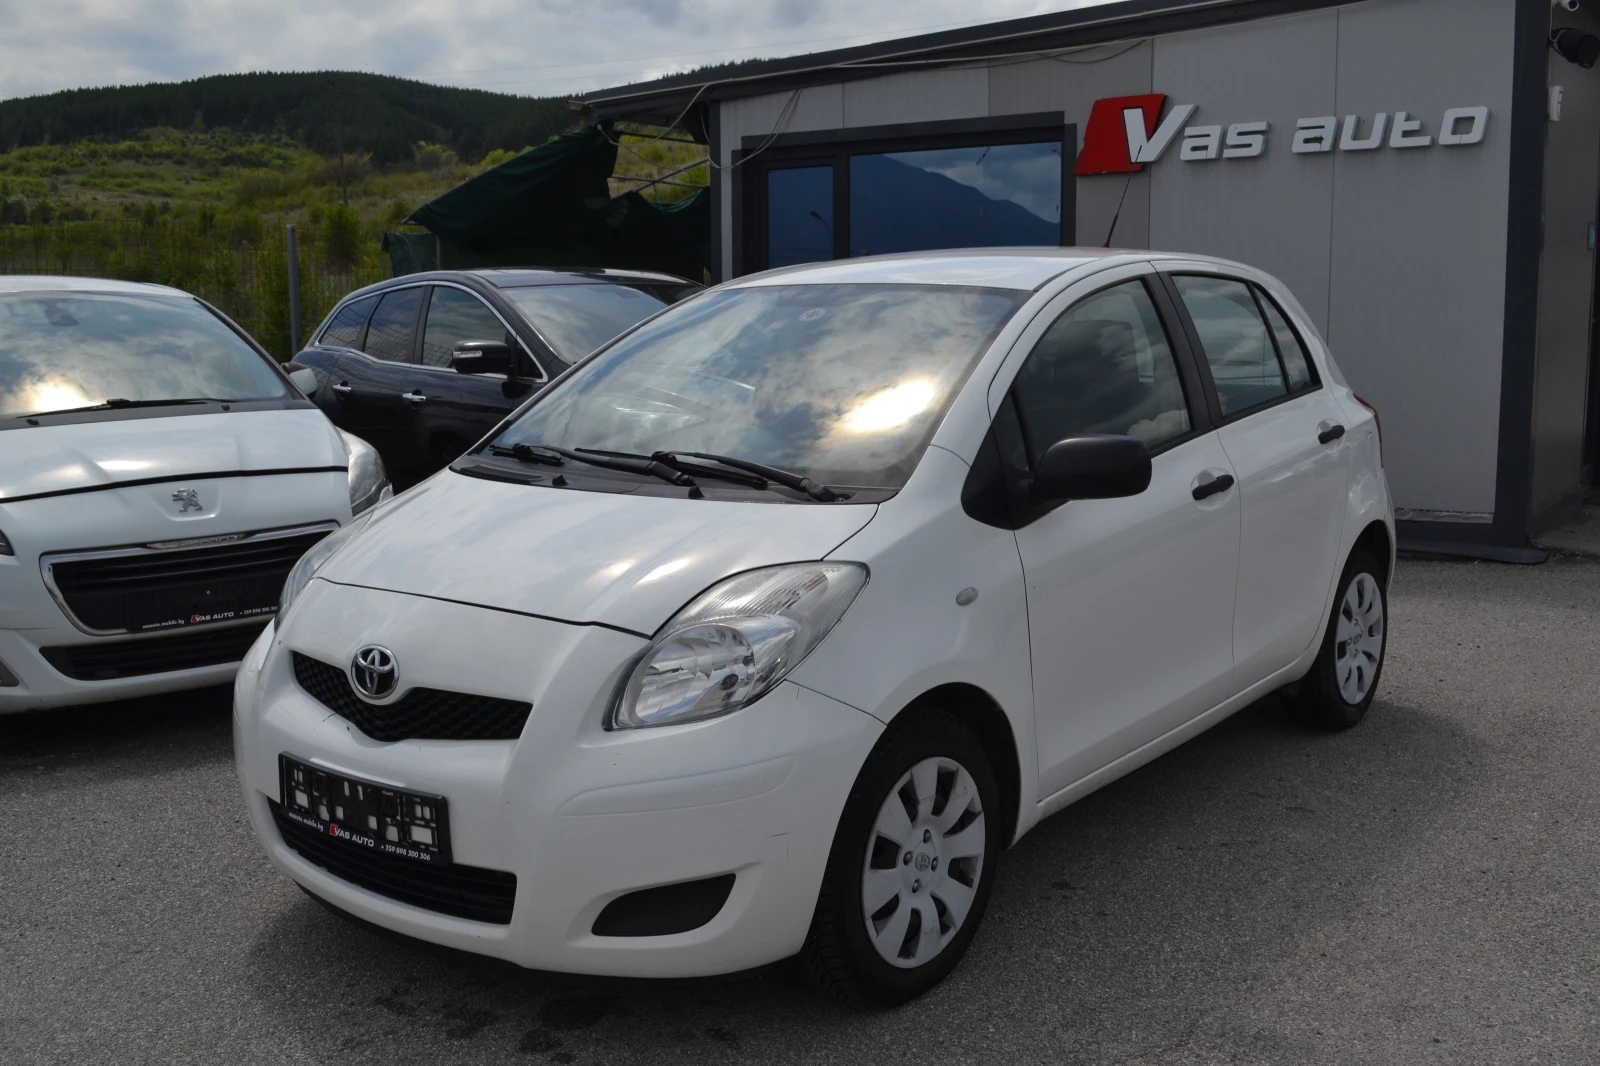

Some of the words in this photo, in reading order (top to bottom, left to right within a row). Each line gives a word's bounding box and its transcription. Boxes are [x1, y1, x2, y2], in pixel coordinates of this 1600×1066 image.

[1122, 103, 1270, 164] Vas
[1292, 105, 1490, 154] auto
[212, 611, 235, 620] AUTO
[334, 826, 350, 840] VAS
[351, 834, 375, 848] AUTO
[384, 844, 396, 853] 359
[395, 847, 407, 856] 898
[407, 849, 419, 859] 300
[419, 852, 431, 861] 306
